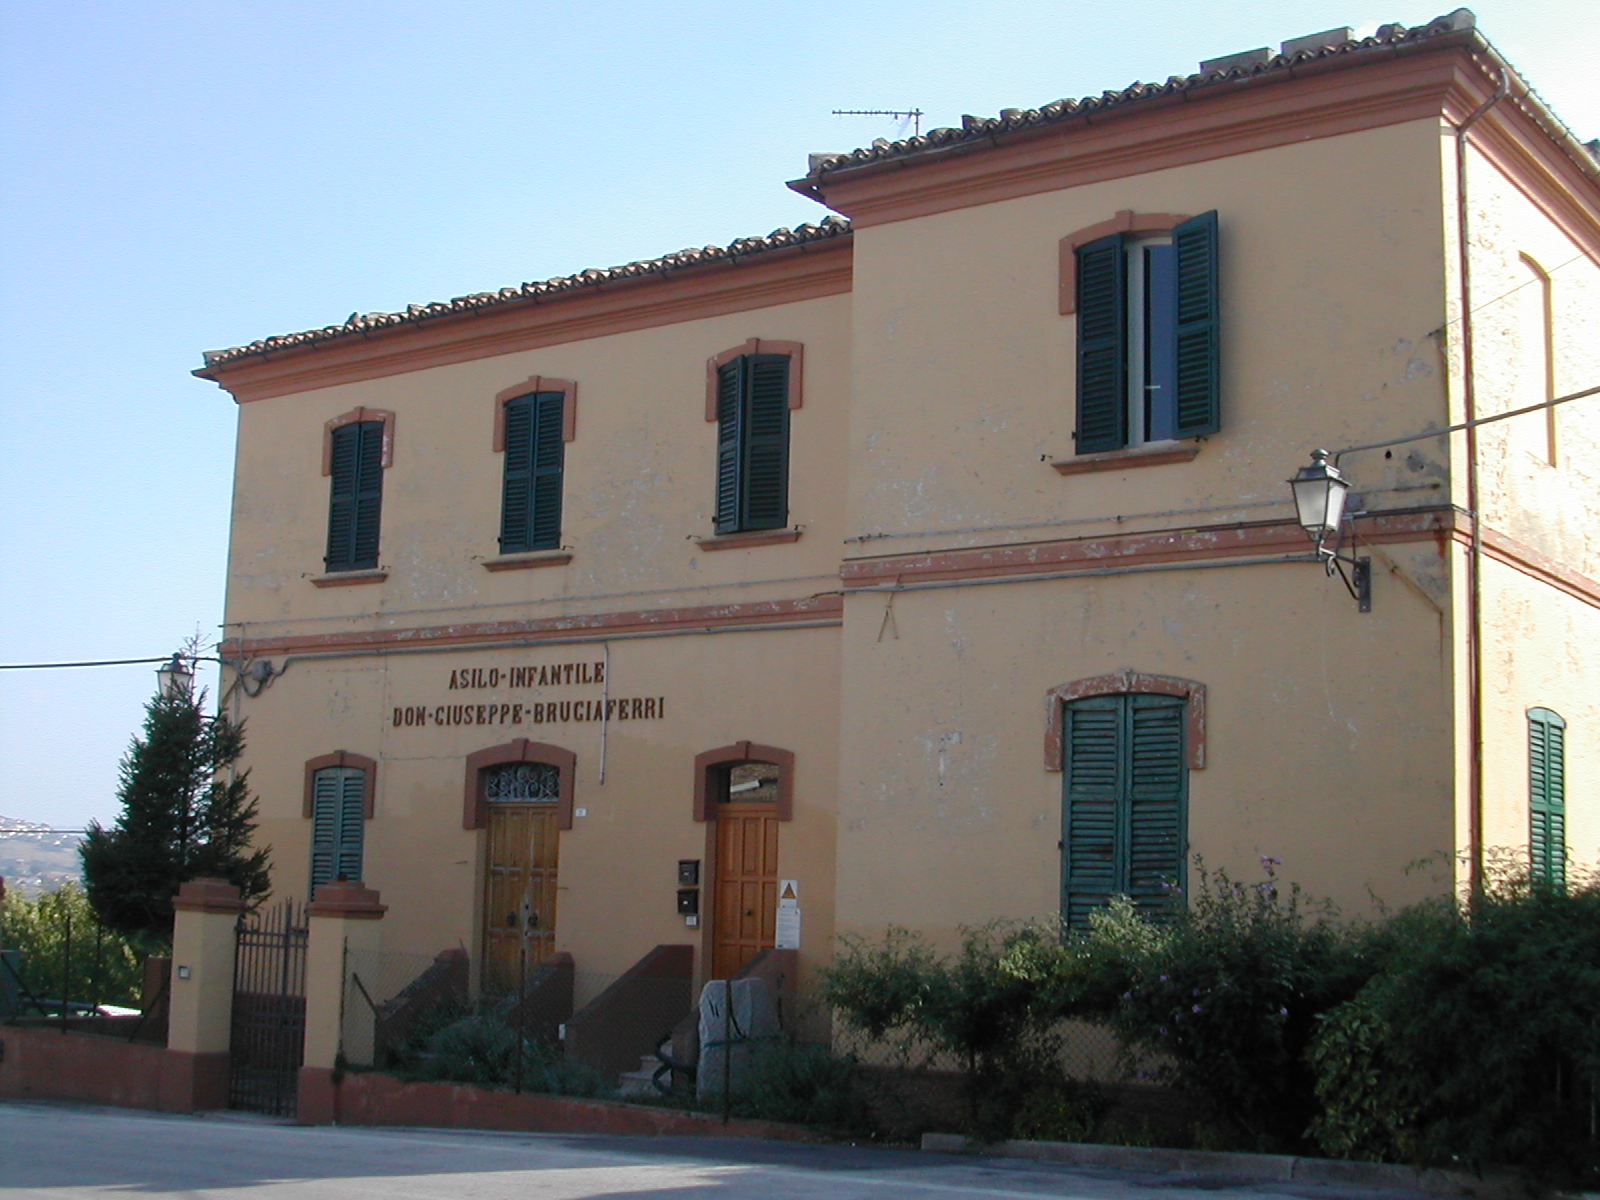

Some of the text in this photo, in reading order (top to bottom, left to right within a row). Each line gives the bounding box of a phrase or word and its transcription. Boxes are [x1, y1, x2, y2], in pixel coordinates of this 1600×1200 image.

[448, 661, 605, 690] ASILO INFANTILE
[392, 706, 426, 727] DON
